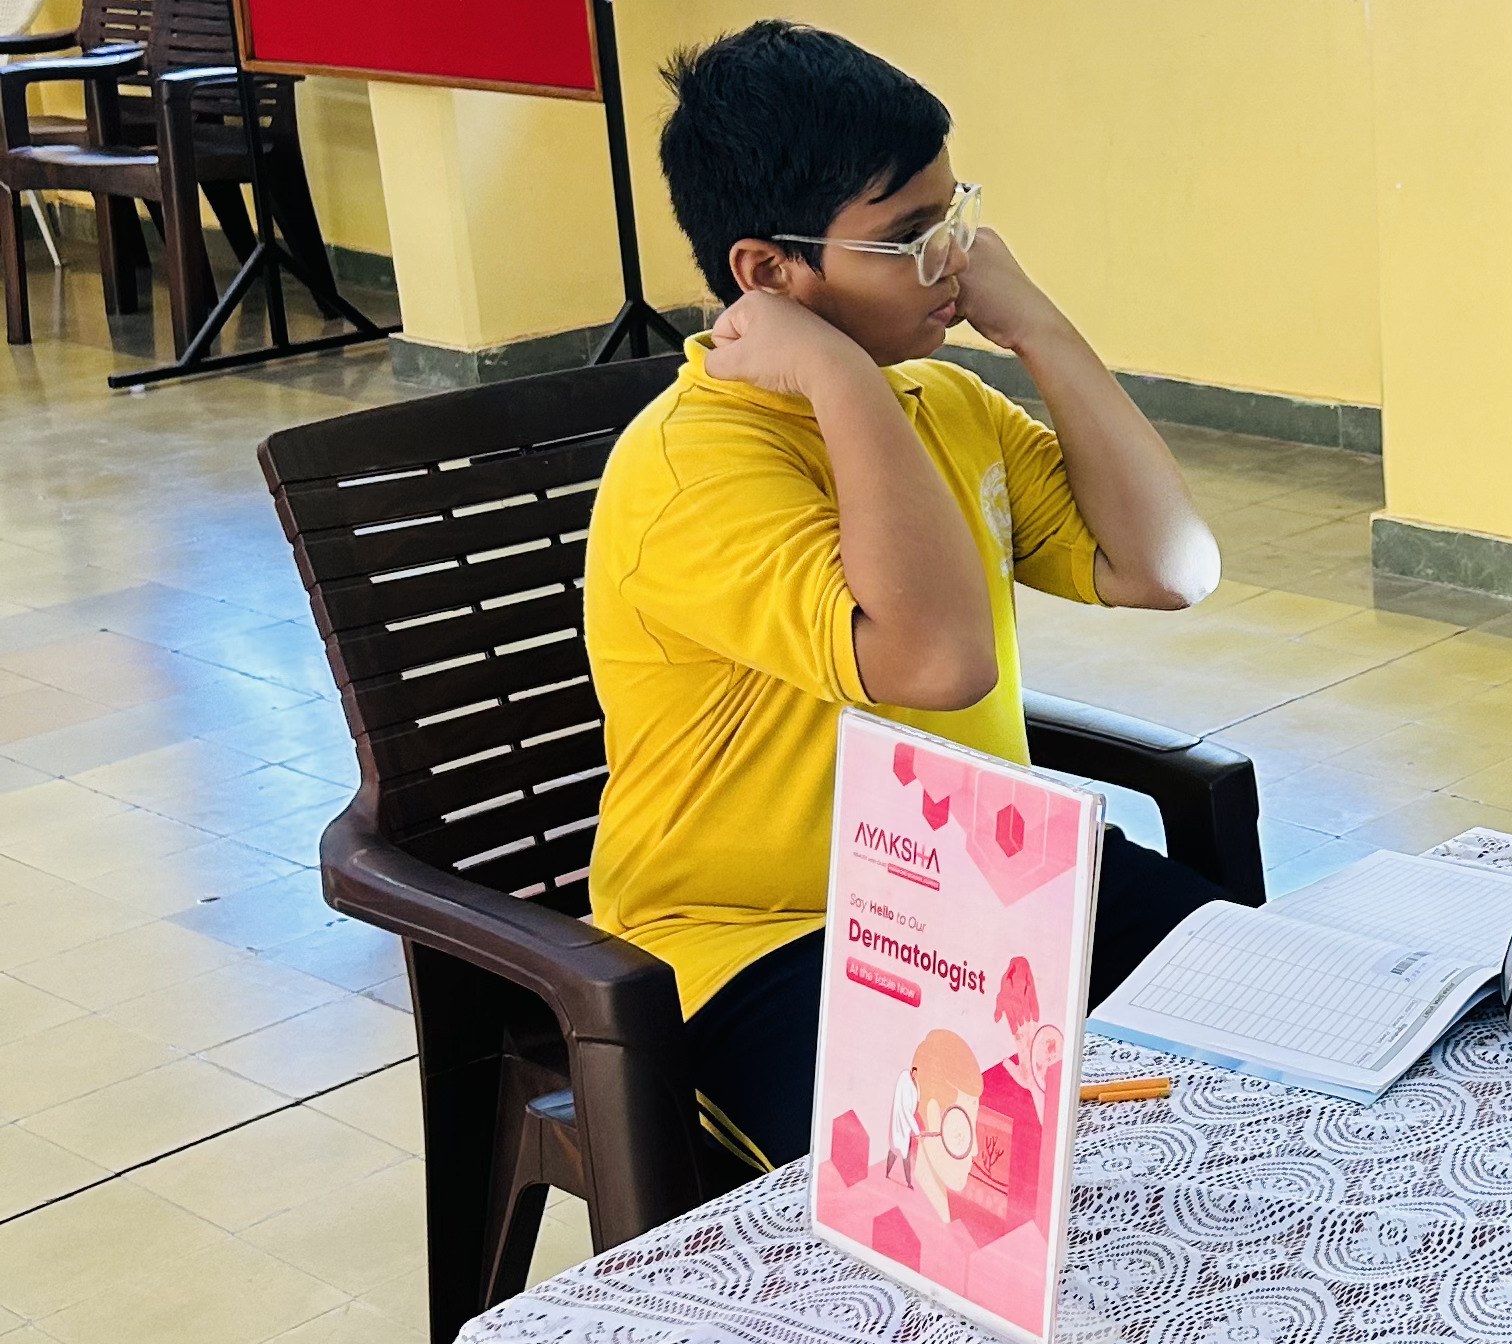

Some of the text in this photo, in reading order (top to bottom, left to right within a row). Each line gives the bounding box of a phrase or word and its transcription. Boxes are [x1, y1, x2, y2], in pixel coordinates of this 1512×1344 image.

[854, 821, 940, 874] AYAKSHA
[849, 893, 927, 933] Say Hello to Our
[848, 917, 986, 995] Dermatologist
